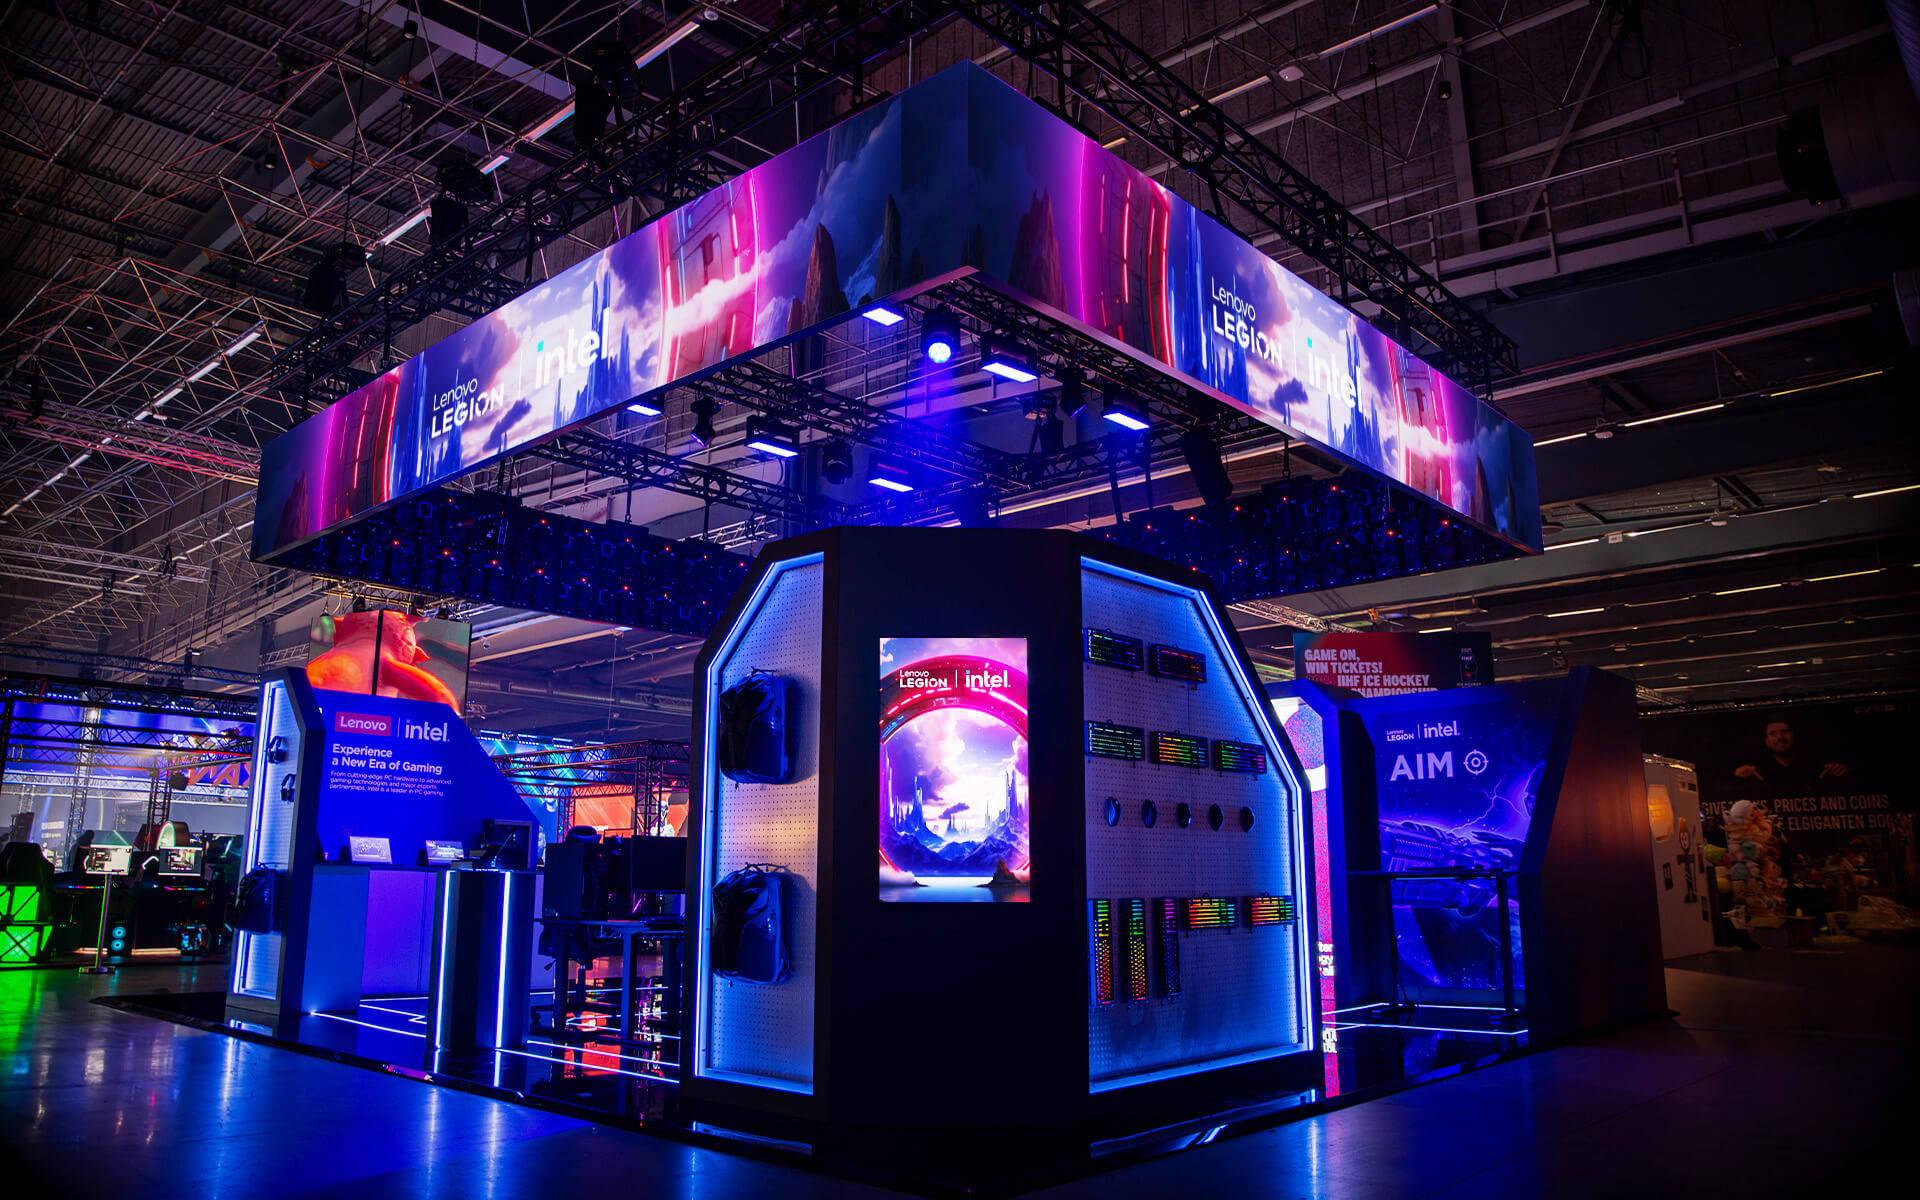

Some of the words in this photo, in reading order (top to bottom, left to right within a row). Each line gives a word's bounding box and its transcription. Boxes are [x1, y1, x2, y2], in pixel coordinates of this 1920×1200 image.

[1211, 276, 1256, 321] Lenovo
[1212, 304, 1283, 369] LEGION
[433, 378, 478, 412] Lenovo
[431, 383, 505, 439] LEGION
[1304, 649, 1337, 661] GAME
[1339, 649, 1361, 663] ON,
[899, 670, 930, 678] Lenovo
[1305, 662, 1329, 674] WIN
[1330, 662, 1383, 674] TICKETS!
[899, 678, 948, 688] LEGION
[1337, 675, 1360, 687] IIHF
[1362, 674, 1381, 687] ICE
[1382, 674, 1430, 687] HOCKEY
[340, 716, 388, 731] Lenovo
[1387, 733, 1415, 742] LEGION
[332, 743, 393, 758] Experience
[331, 757, 339, 766] a
[341, 756, 367, 768] New
[369, 758, 387, 770] Era
[388, 760, 400, 771] of
[402, 761, 443, 776] Gaming
[1390, 751, 1454, 781] AIM
[330, 777, 352, 785] gaming
[353, 778, 388, 787] technologies
[347, 772, 383, 780] cutting-edge
[1774, 796, 1818, 813] PRICES
[1820, 795, 1847, 811] AND
[1849, 793, 1889, 810] COINS
[1788, 813, 1865, 831] ELGIGANTEN
